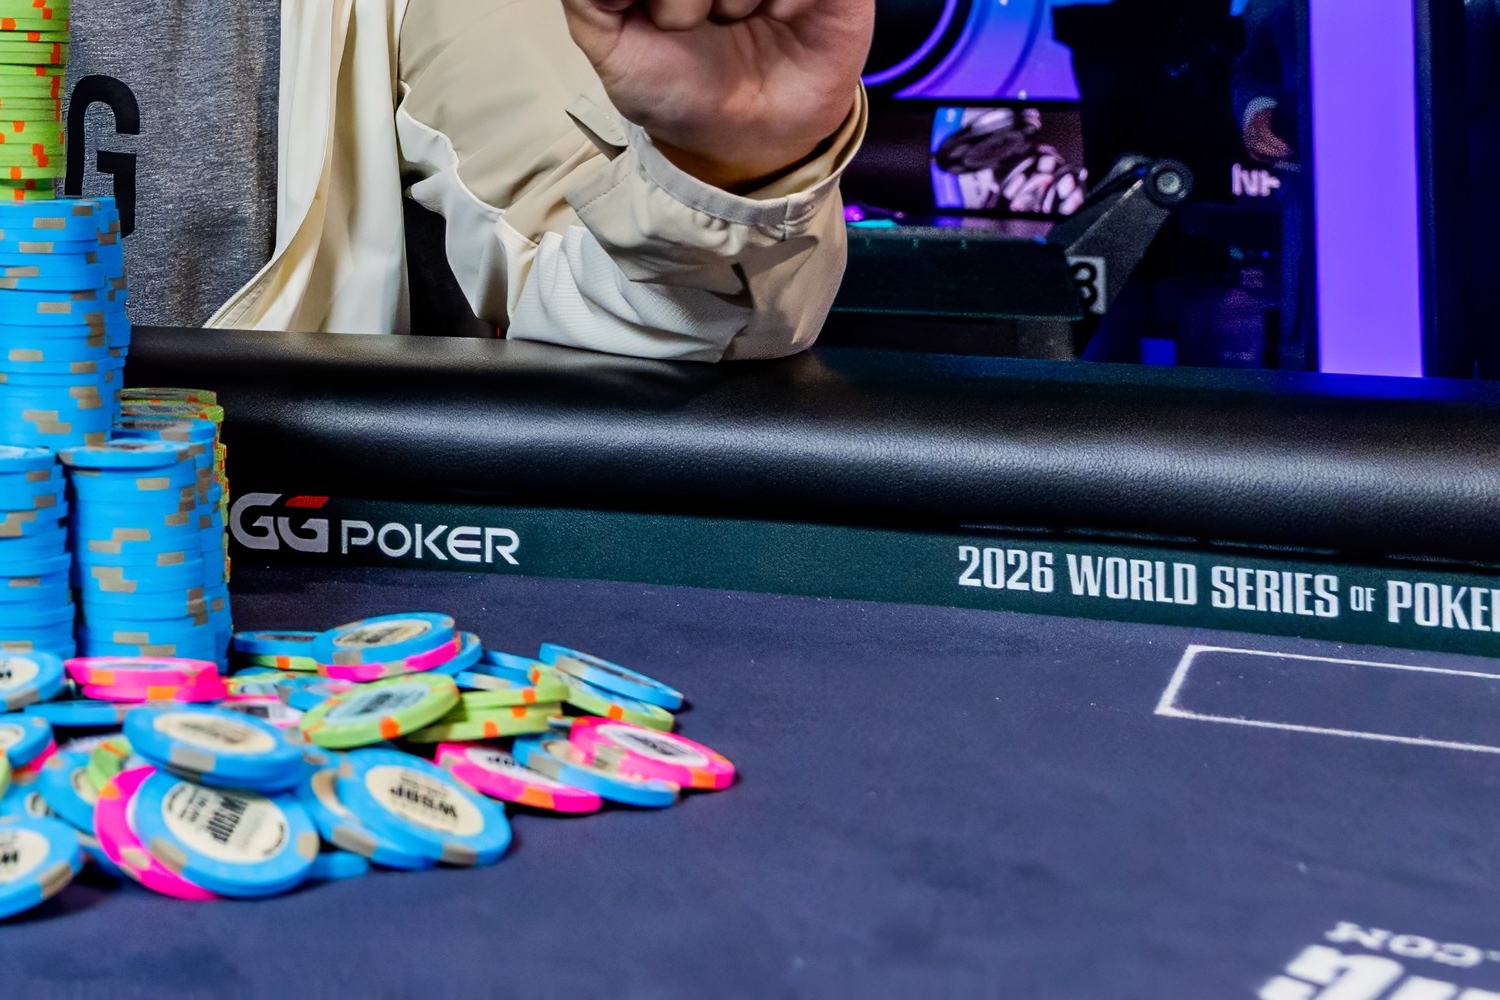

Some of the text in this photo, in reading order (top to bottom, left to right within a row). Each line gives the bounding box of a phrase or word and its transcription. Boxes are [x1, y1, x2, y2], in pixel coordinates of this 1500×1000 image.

[958, 545, 1054, 593] 2026
[1066, 553, 1198, 606] WORLD
[1211, 564, 1339, 619] SERIES
[1350, 585, 1376, 613] OF
